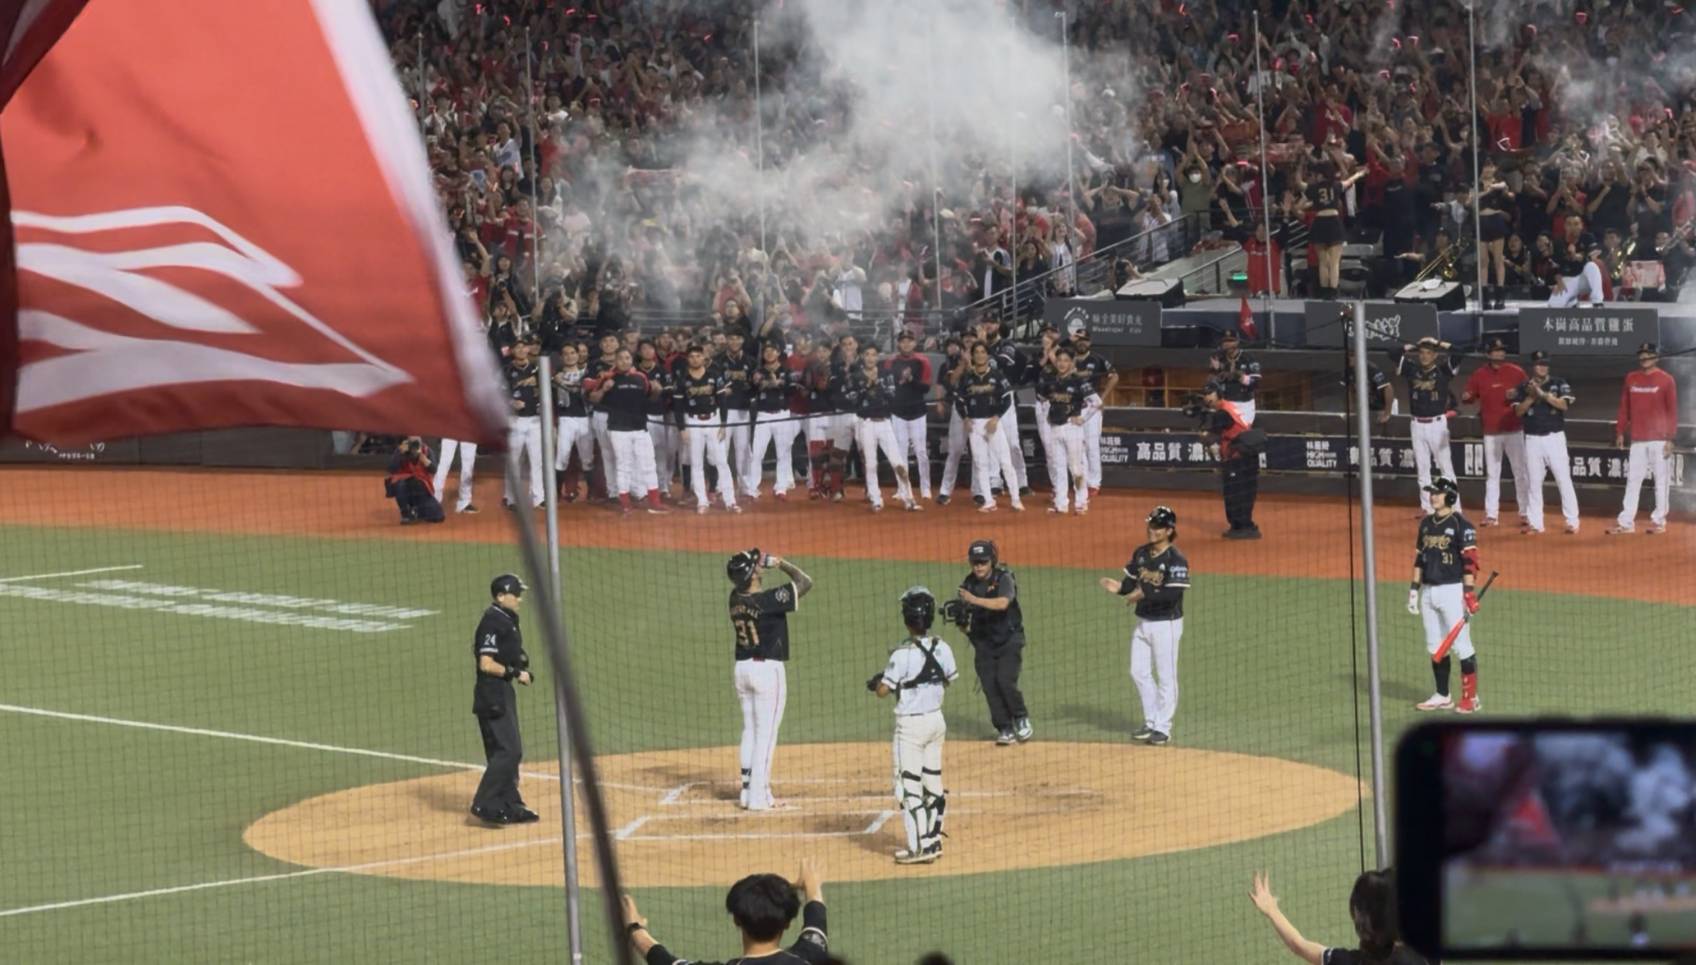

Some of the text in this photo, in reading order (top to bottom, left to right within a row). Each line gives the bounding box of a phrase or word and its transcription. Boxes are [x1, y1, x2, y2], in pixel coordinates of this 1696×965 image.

[1318, 187, 1334, 202] 31
[1136, 442, 1183, 462] 高品質
[1306, 459, 1337, 468] QUALITY
[1441, 552, 1453, 565] 31
[483, 633, 496, 646] 24
[735, 619, 760, 646] 31
